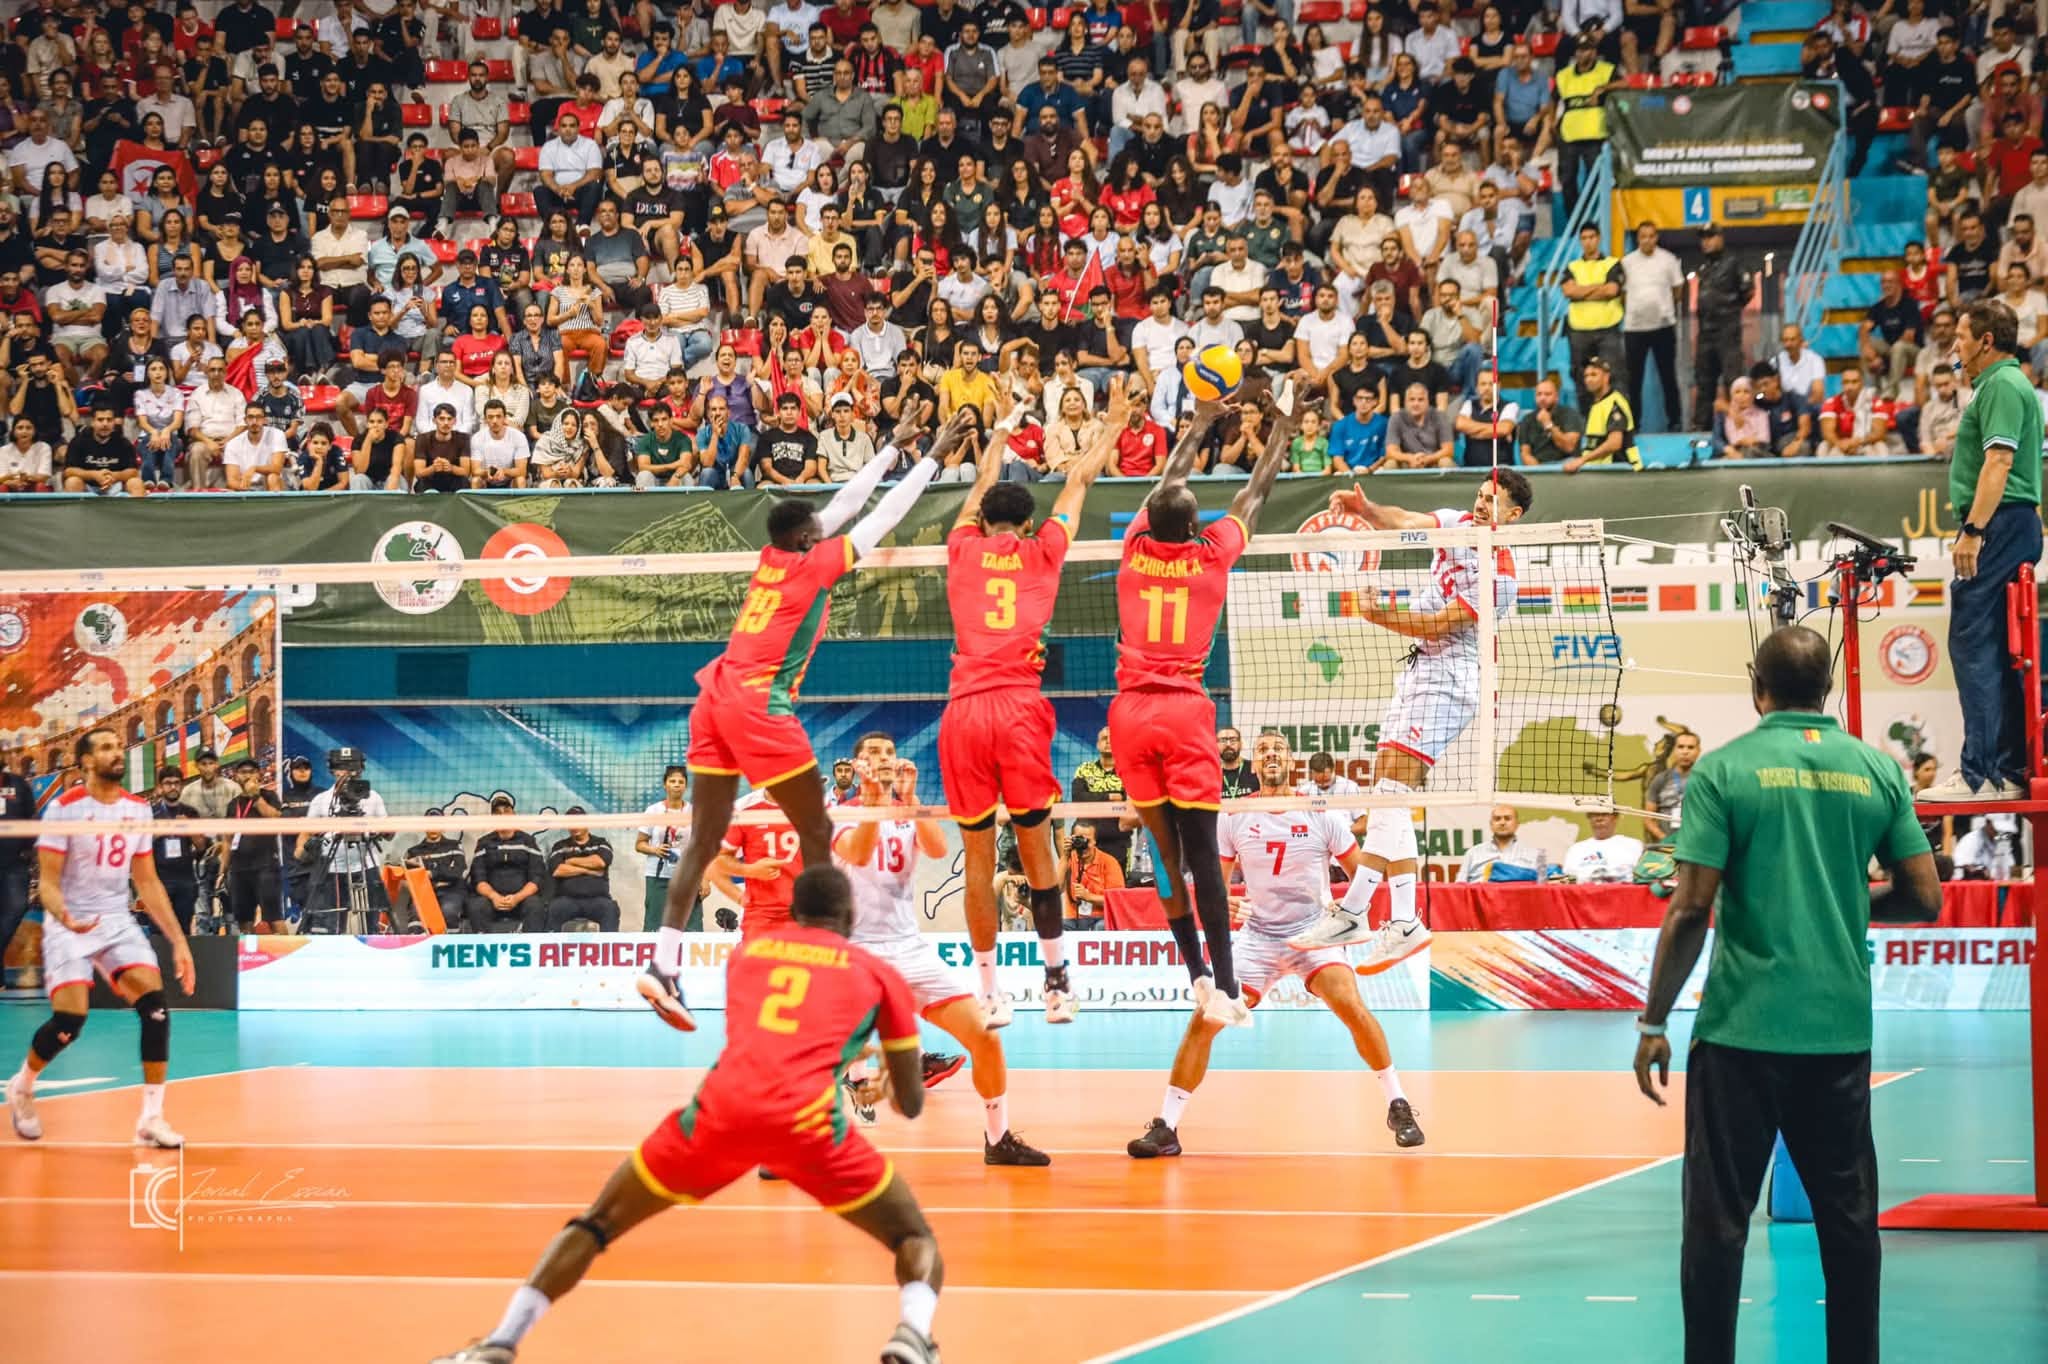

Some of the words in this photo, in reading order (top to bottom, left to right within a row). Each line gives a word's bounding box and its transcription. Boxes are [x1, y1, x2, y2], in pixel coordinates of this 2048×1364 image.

[636, 201, 668, 215] DIOR
[1691, 191, 1704, 218] 4
[1400, 531, 1428, 541] FIVB
[982, 552, 1023, 571] TANGA
[736, 587, 783, 634] 19
[985, 578, 1016, 630] 3
[1139, 585, 1189, 644] 11
[1553, 635, 1622, 659] FIVB
[96, 833, 126, 867] 18
[763, 832, 800, 862] 19
[877, 836, 905, 873] 13
[1266, 841, 1287, 876] 7
[431, 943, 531, 968] MEN'S
[539, 943, 682, 968] AFRICA
[757, 966, 811, 1034] 2
